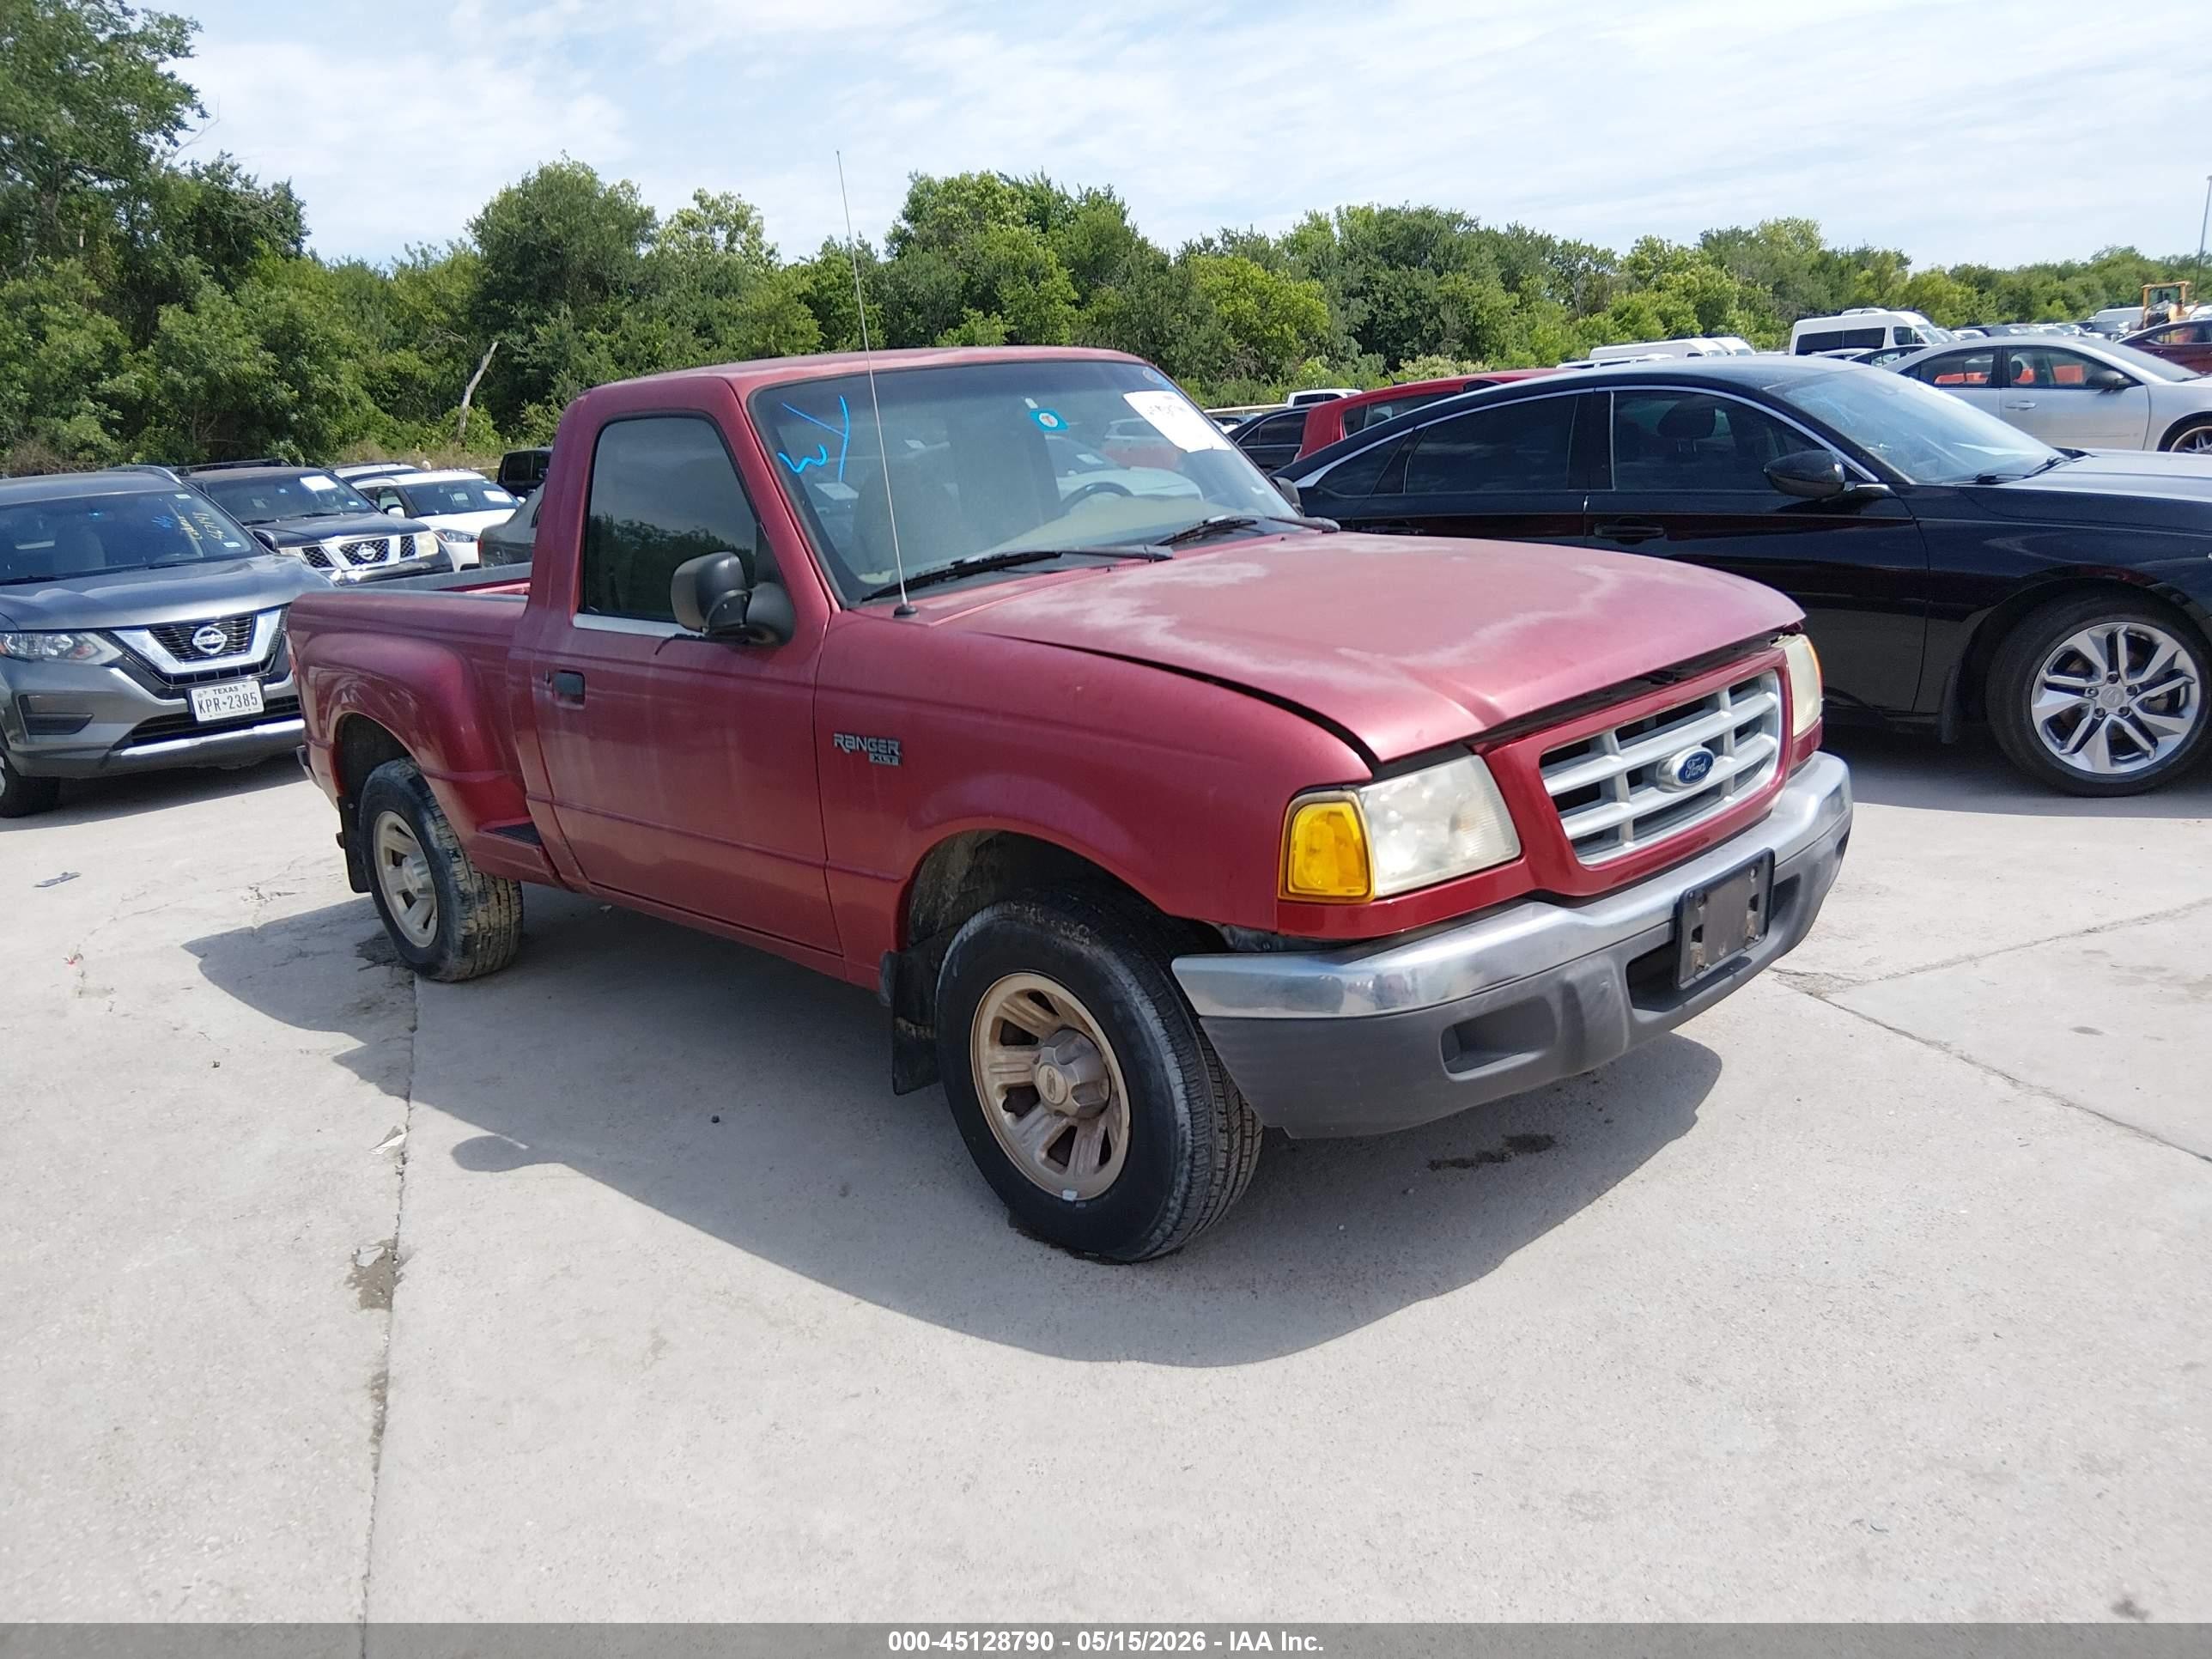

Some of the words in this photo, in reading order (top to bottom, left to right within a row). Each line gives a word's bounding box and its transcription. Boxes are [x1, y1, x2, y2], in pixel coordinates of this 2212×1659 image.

[212, 686, 239, 695] TEXAS
[833, 732, 900, 755] RANGER
[1685, 756, 1706, 779] Ford
